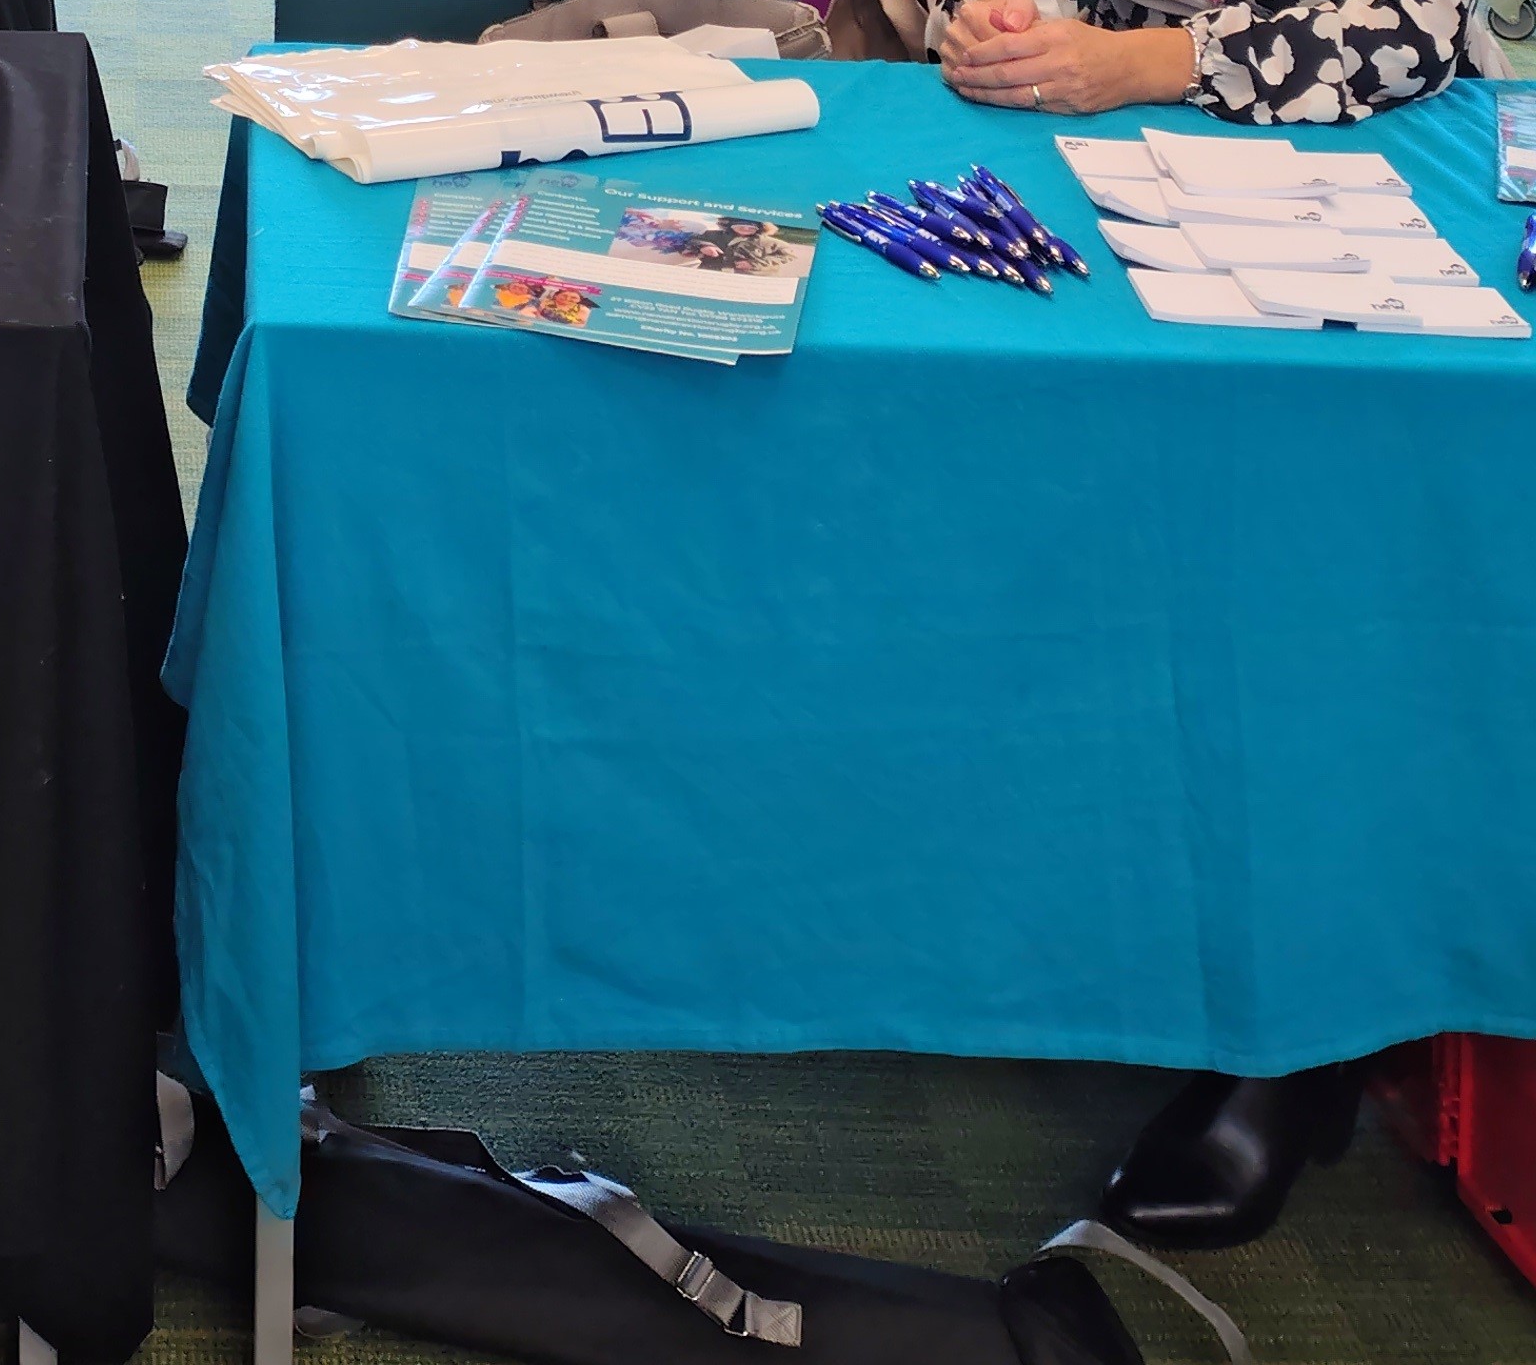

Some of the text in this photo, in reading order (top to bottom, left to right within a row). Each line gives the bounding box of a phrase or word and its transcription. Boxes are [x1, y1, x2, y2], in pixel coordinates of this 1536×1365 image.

[604, 189, 803, 219] Our Support and Services
